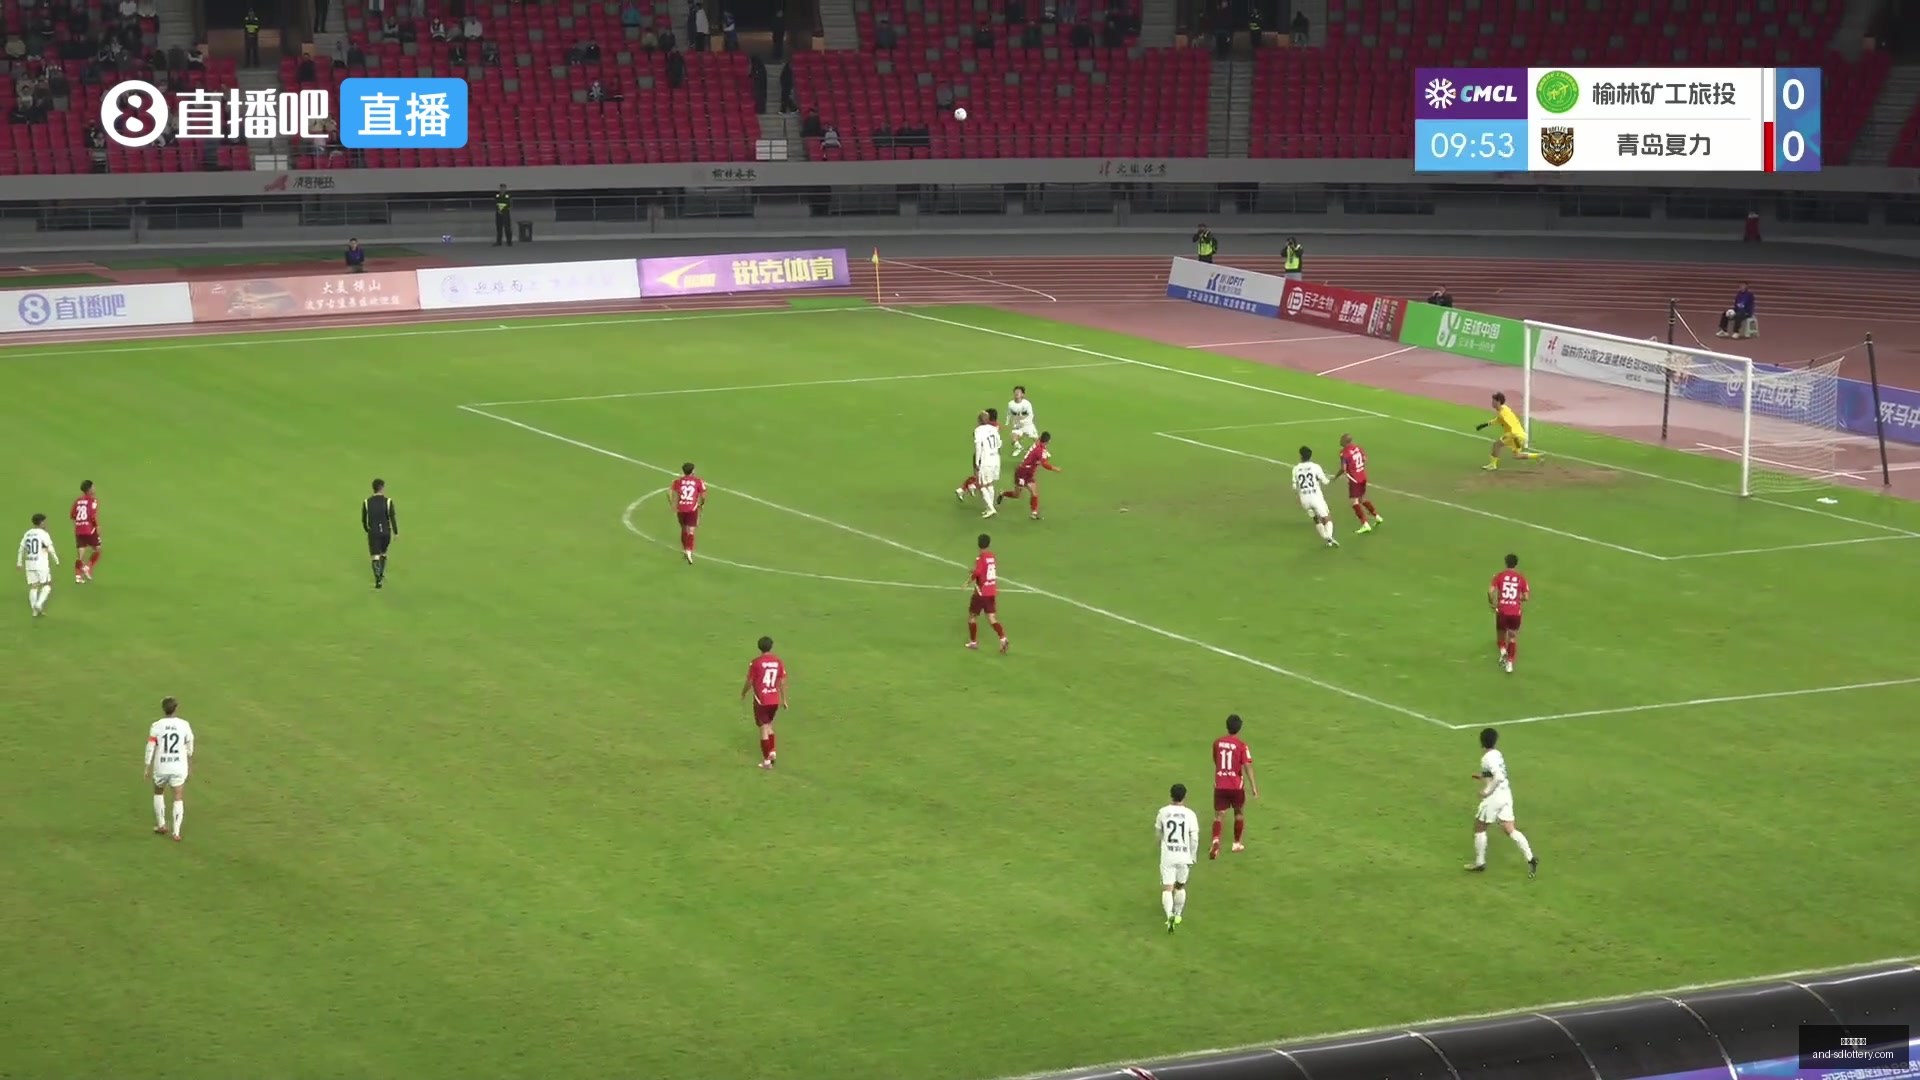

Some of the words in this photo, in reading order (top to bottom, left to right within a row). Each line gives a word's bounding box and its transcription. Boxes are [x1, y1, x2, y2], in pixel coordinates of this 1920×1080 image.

[732, 257, 835, 286] 锐克体育
[55, 293, 126, 320] 直播吧
[1461, 318, 1501, 340] 足球中国
[986, 434, 996, 449] 17
[1298, 472, 1315, 489] 23
[680, 485, 695, 500] 32
[76, 505, 88, 521] 28
[25, 538, 39, 555] 60
[1501, 581, 1519, 600] 55
[762, 668, 778, 688] 47
[162, 733, 179, 754] 12
[1220, 749, 1233, 771] 11
[1166, 820, 1186, 844] 21
